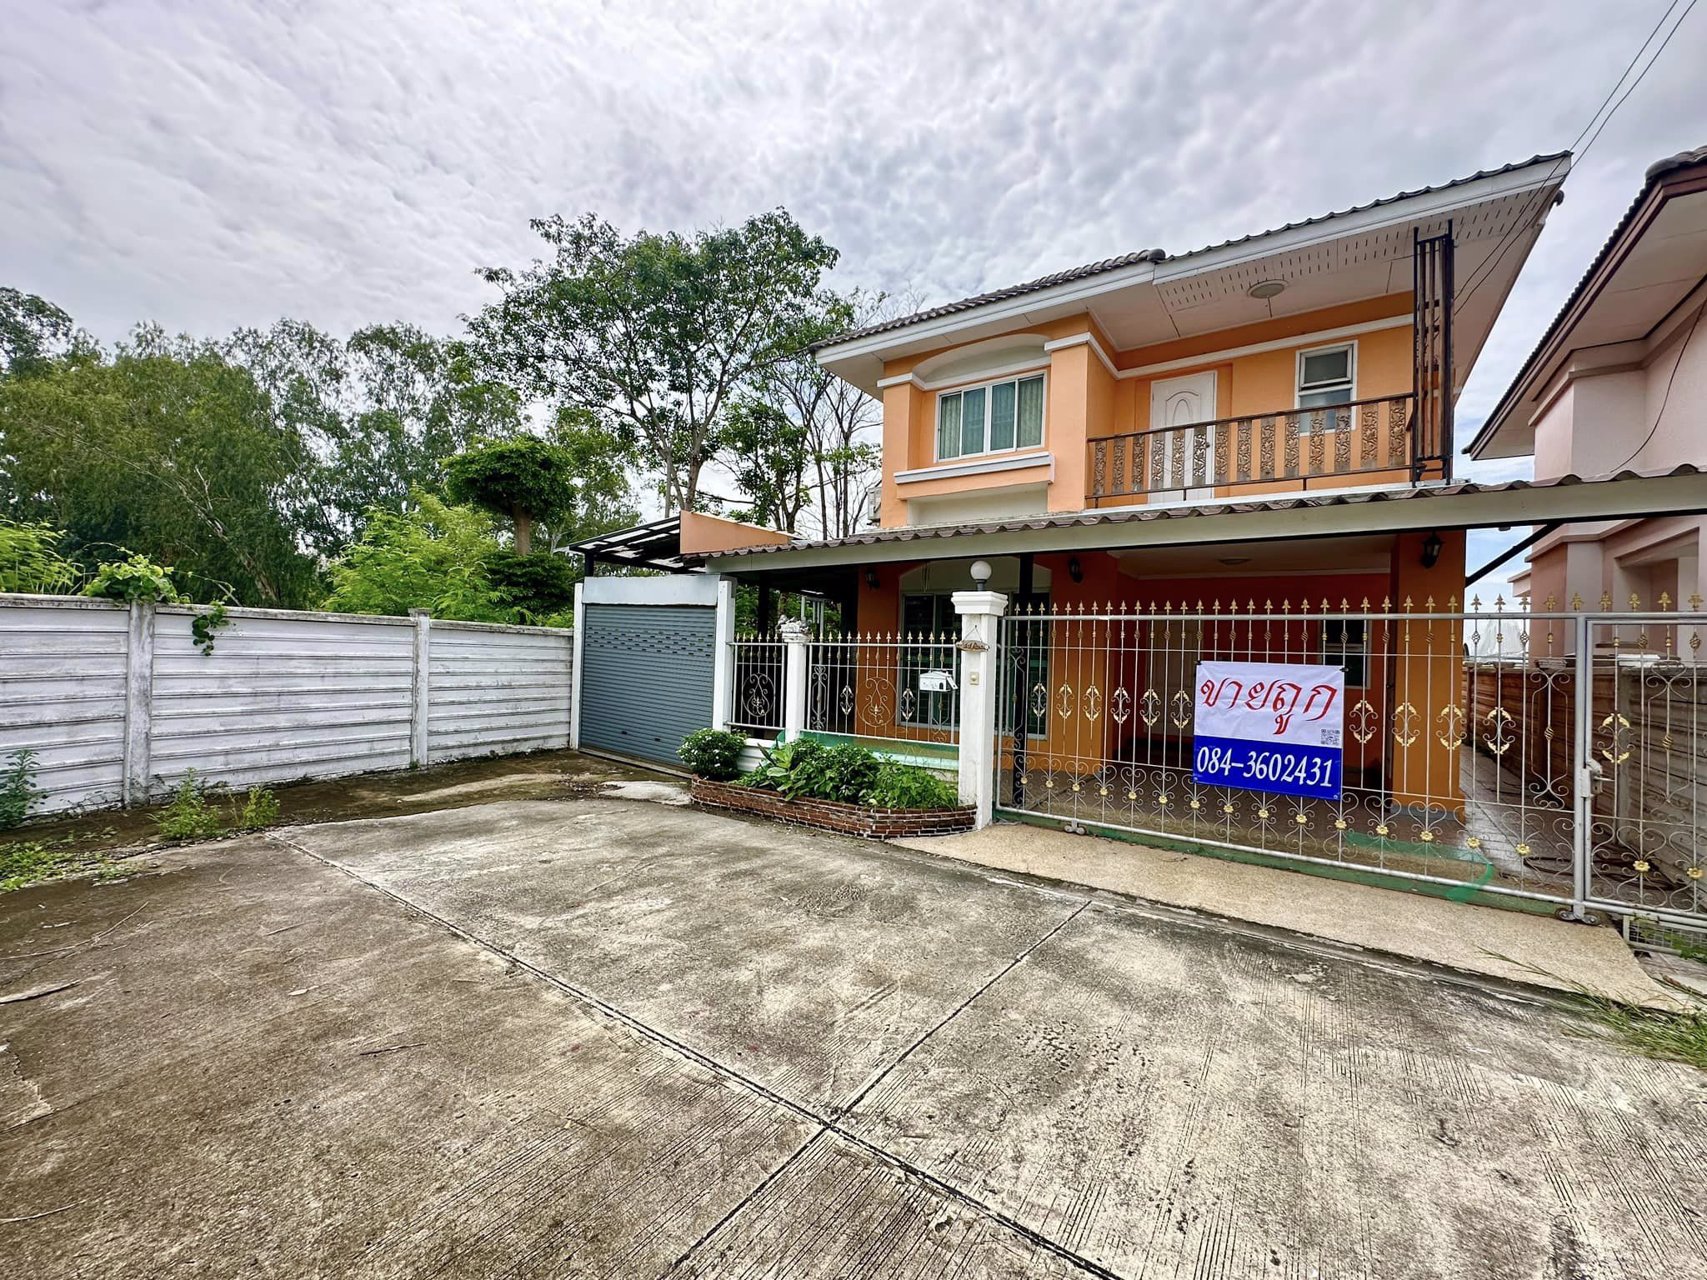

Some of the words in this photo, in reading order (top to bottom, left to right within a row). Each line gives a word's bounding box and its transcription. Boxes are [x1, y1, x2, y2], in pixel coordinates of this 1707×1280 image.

[1200, 677, 1338, 735] ขายถูก
[1197, 746, 1333, 787] 084-3602431
